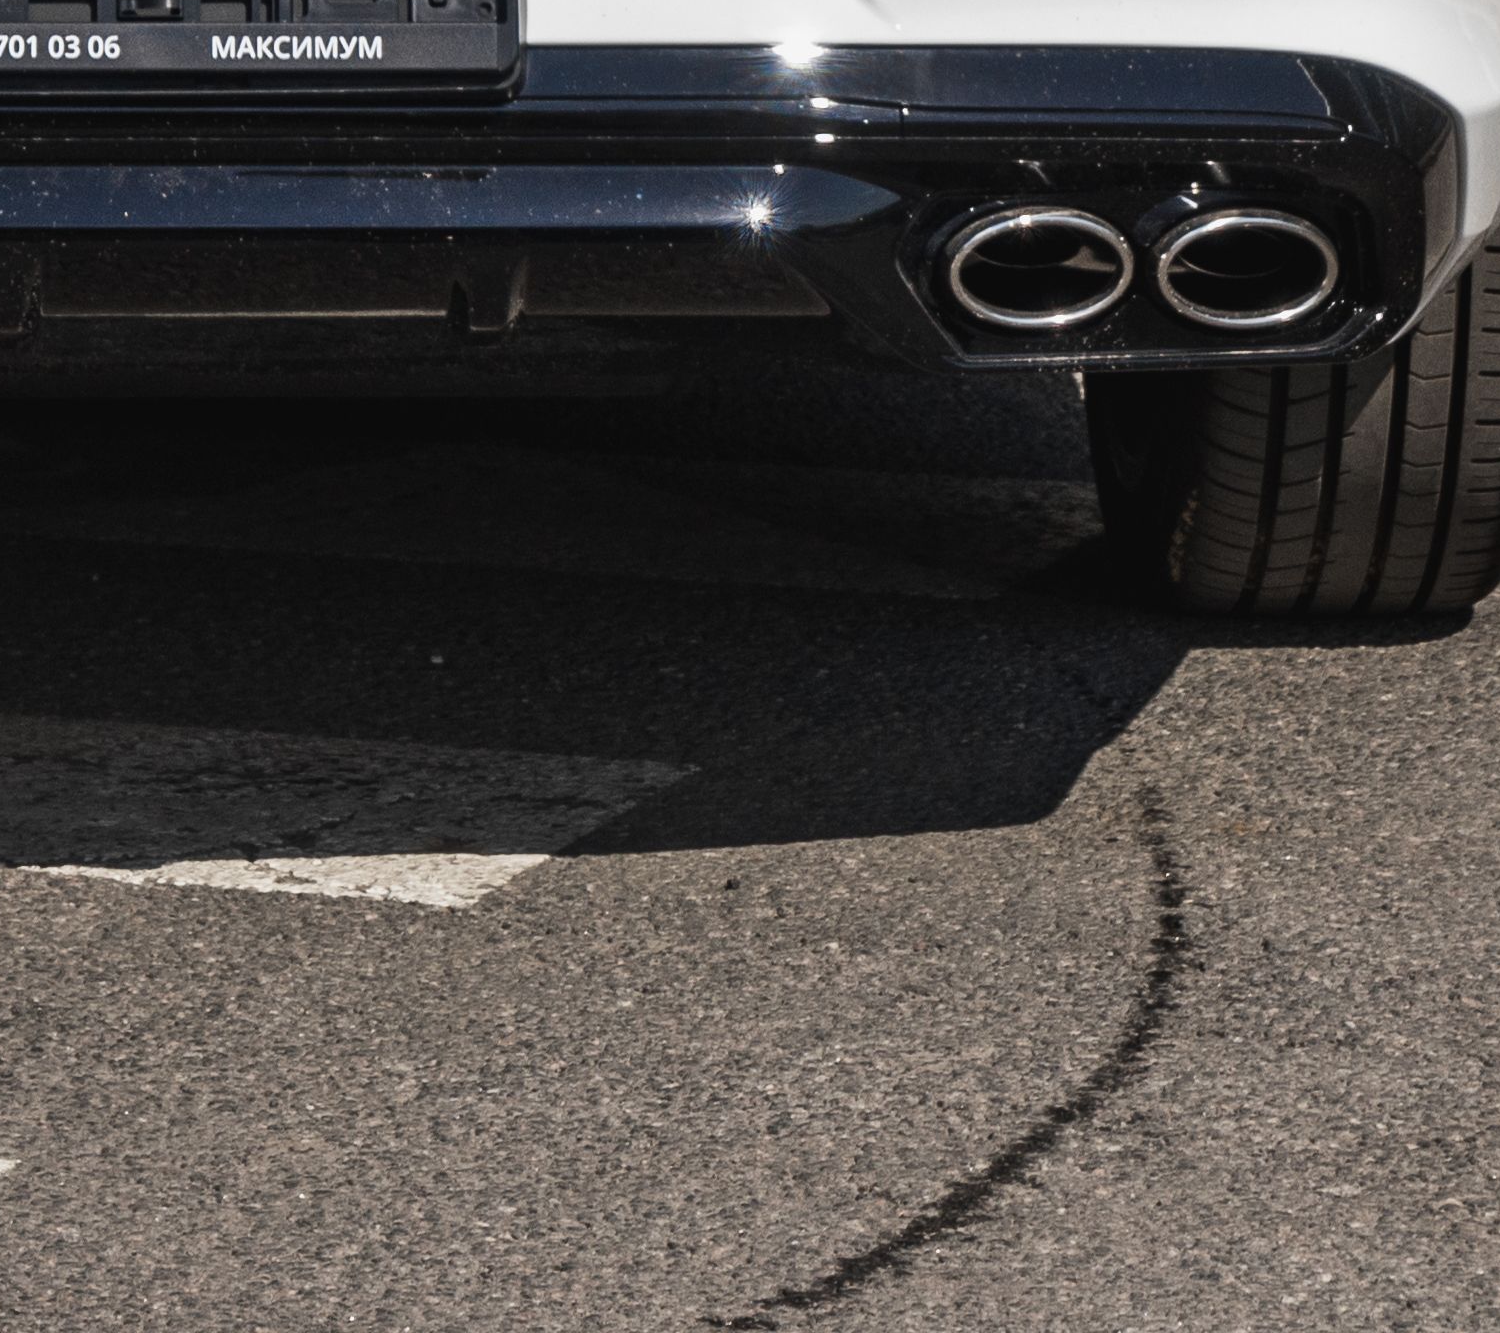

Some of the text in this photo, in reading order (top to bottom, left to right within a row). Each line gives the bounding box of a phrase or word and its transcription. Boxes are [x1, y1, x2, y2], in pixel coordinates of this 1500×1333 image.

[48, 35, 82, 58] 03
[88, 35, 121, 58] 06
[212, 36, 384, 59] МАКСИМУМ
